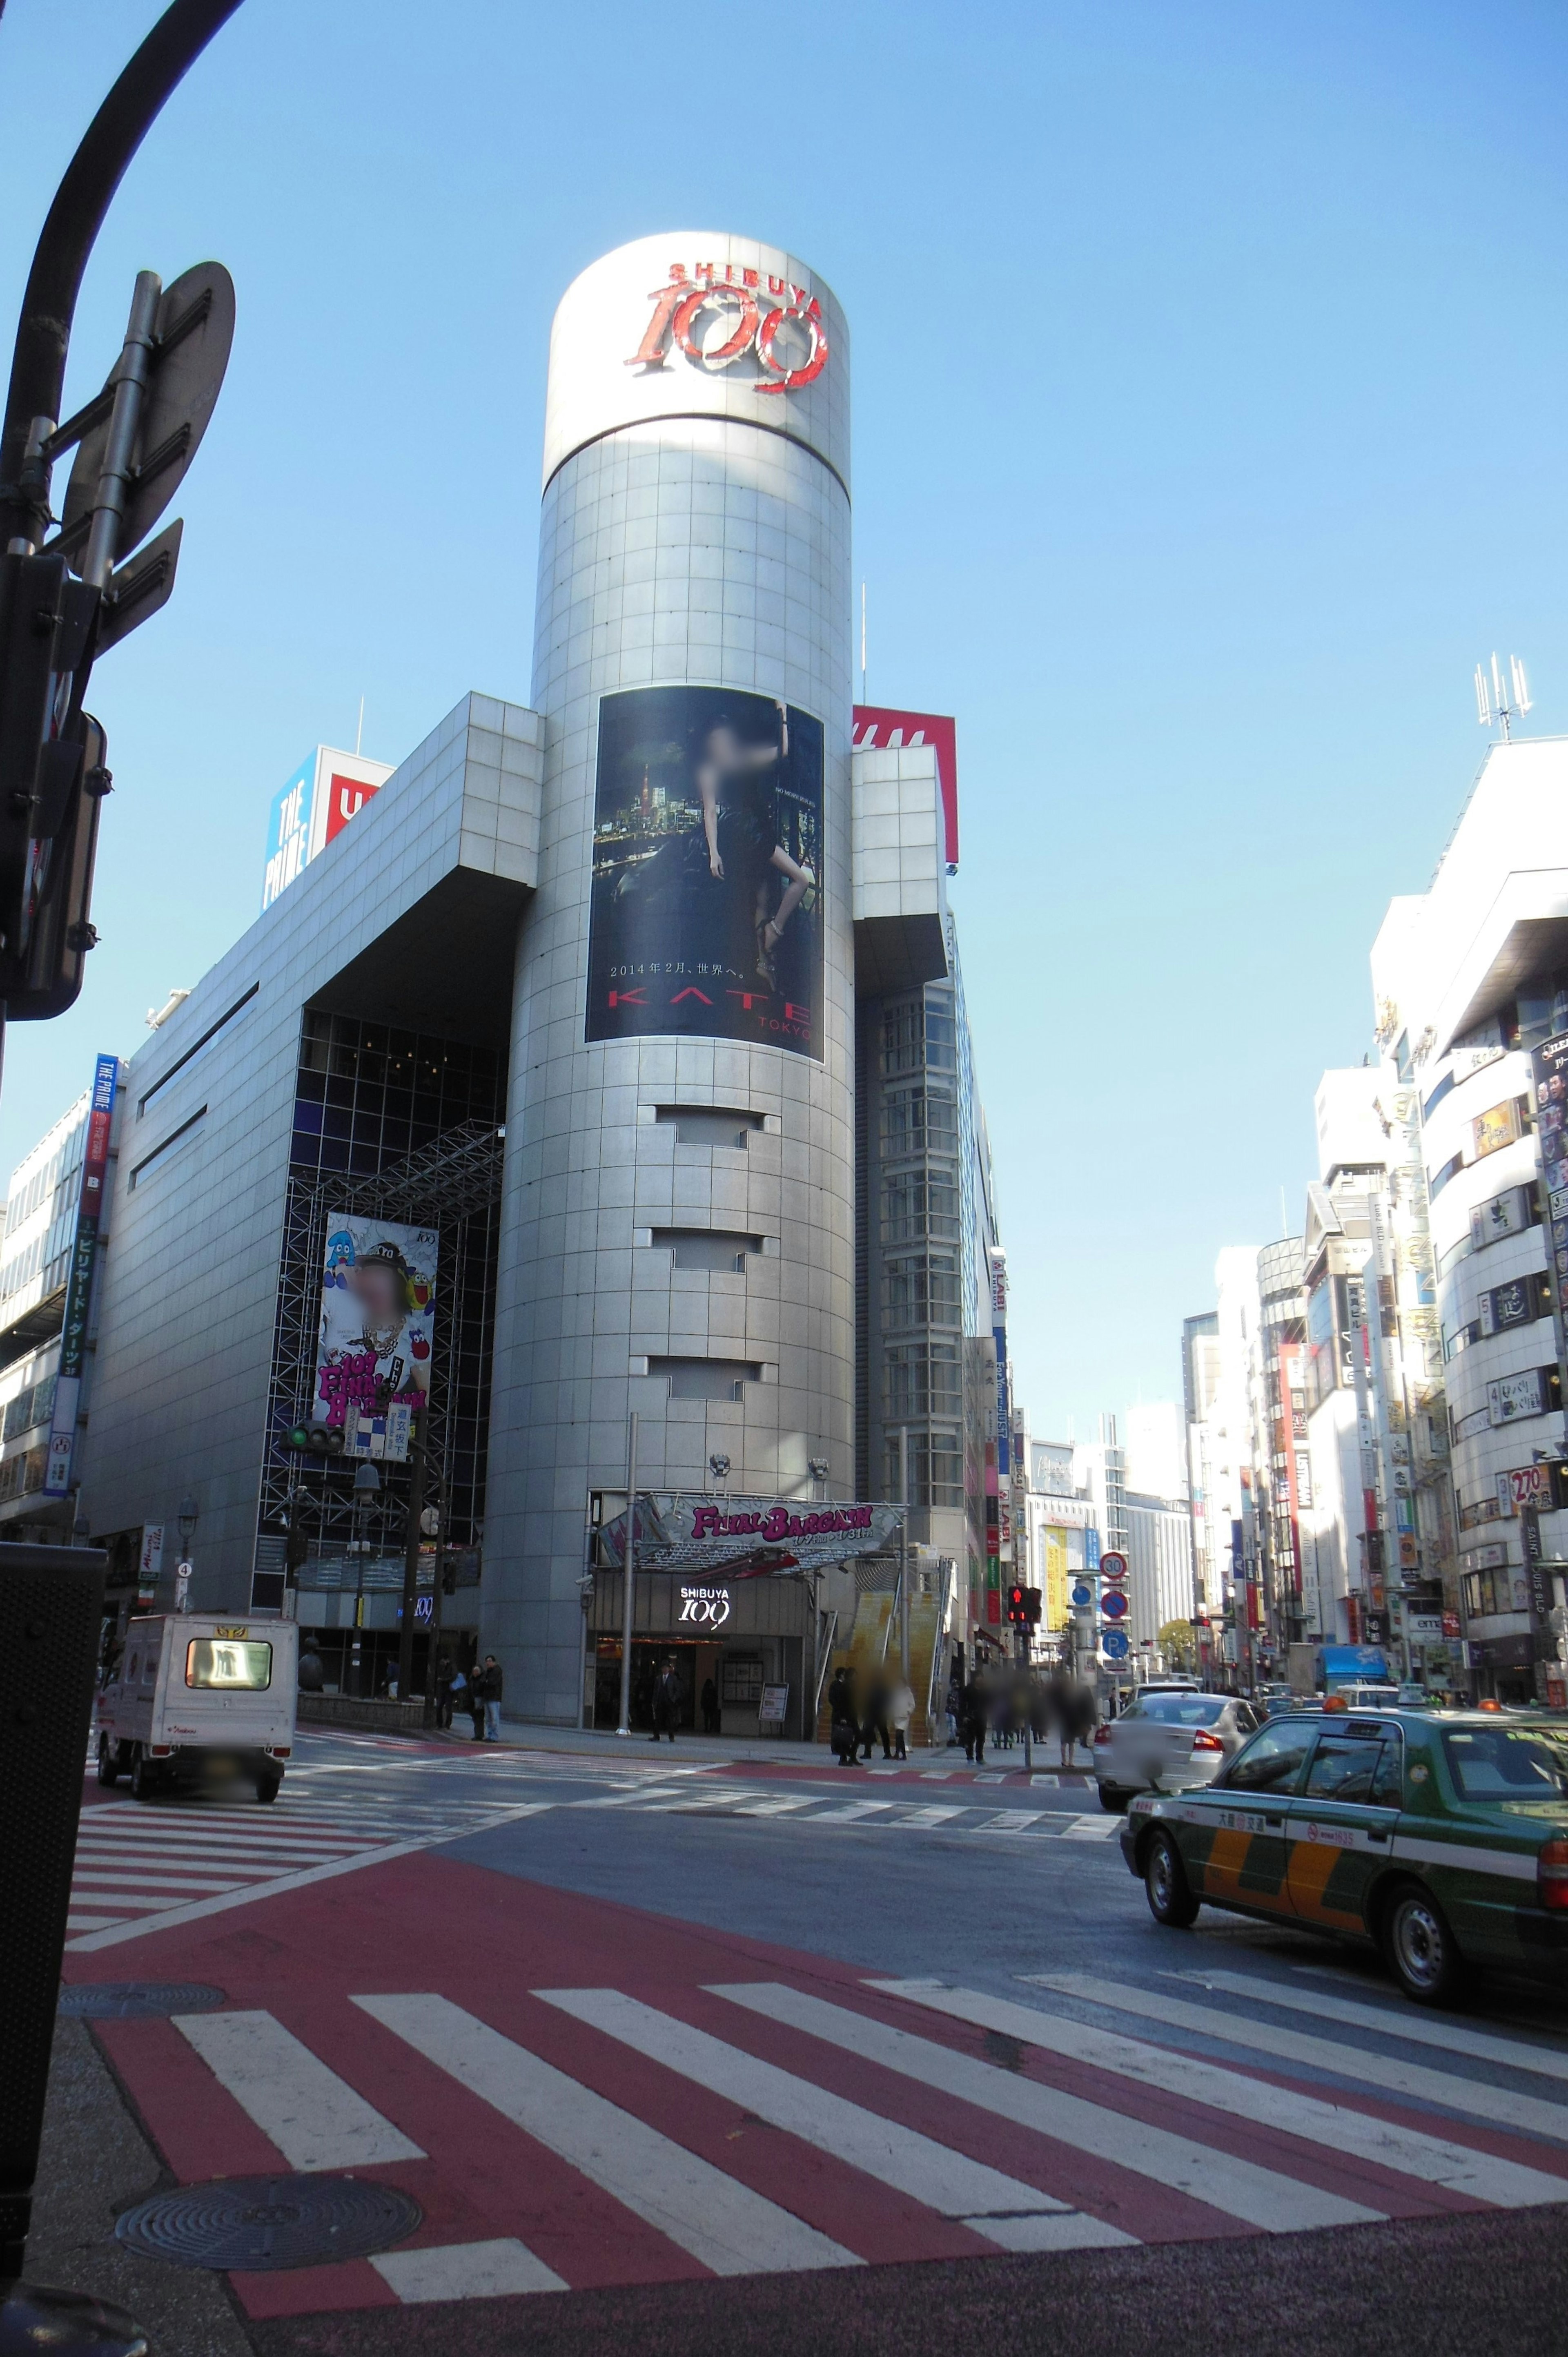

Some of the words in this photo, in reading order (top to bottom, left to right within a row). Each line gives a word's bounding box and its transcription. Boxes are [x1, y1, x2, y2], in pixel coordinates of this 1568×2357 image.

[669, 263, 822, 320] SHIBUYA
[623, 281, 828, 395] 109
[278, 779, 305, 847] THE
[610, 962, 744, 979] 2014年2月、世界へ。
[758, 1016, 811, 1040] TOKYO
[98, 1062, 115, 1079] THE
[95, 1079, 112, 1109] PRIME
[1376, 1226, 1385, 1241] BLD
[66, 1238, 93, 1364] ビリヤード・ダーツ
[65, 1367, 76, 1375] 3F
[341, 1351, 378, 1377] 109
[394, 1409, 407, 1456] 道玄坂下
[1512, 1467, 1540, 1502] 270
[691, 1505, 768, 1539] FINAL
[762, 1505, 873, 1542] BARGAIN
[181, 1564, 188, 1575] 4
[1106, 1560, 1121, 1572] 30
[1528, 1526, 1538, 1556] SAINT
[1536, 1593, 1545, 1613] BLD
[681, 1588, 729, 1599] SHIBUYA
[414, 1597, 434, 1624] 109
[678, 1599, 730, 1631] 109
[1108, 1637, 1119, 1655] P
